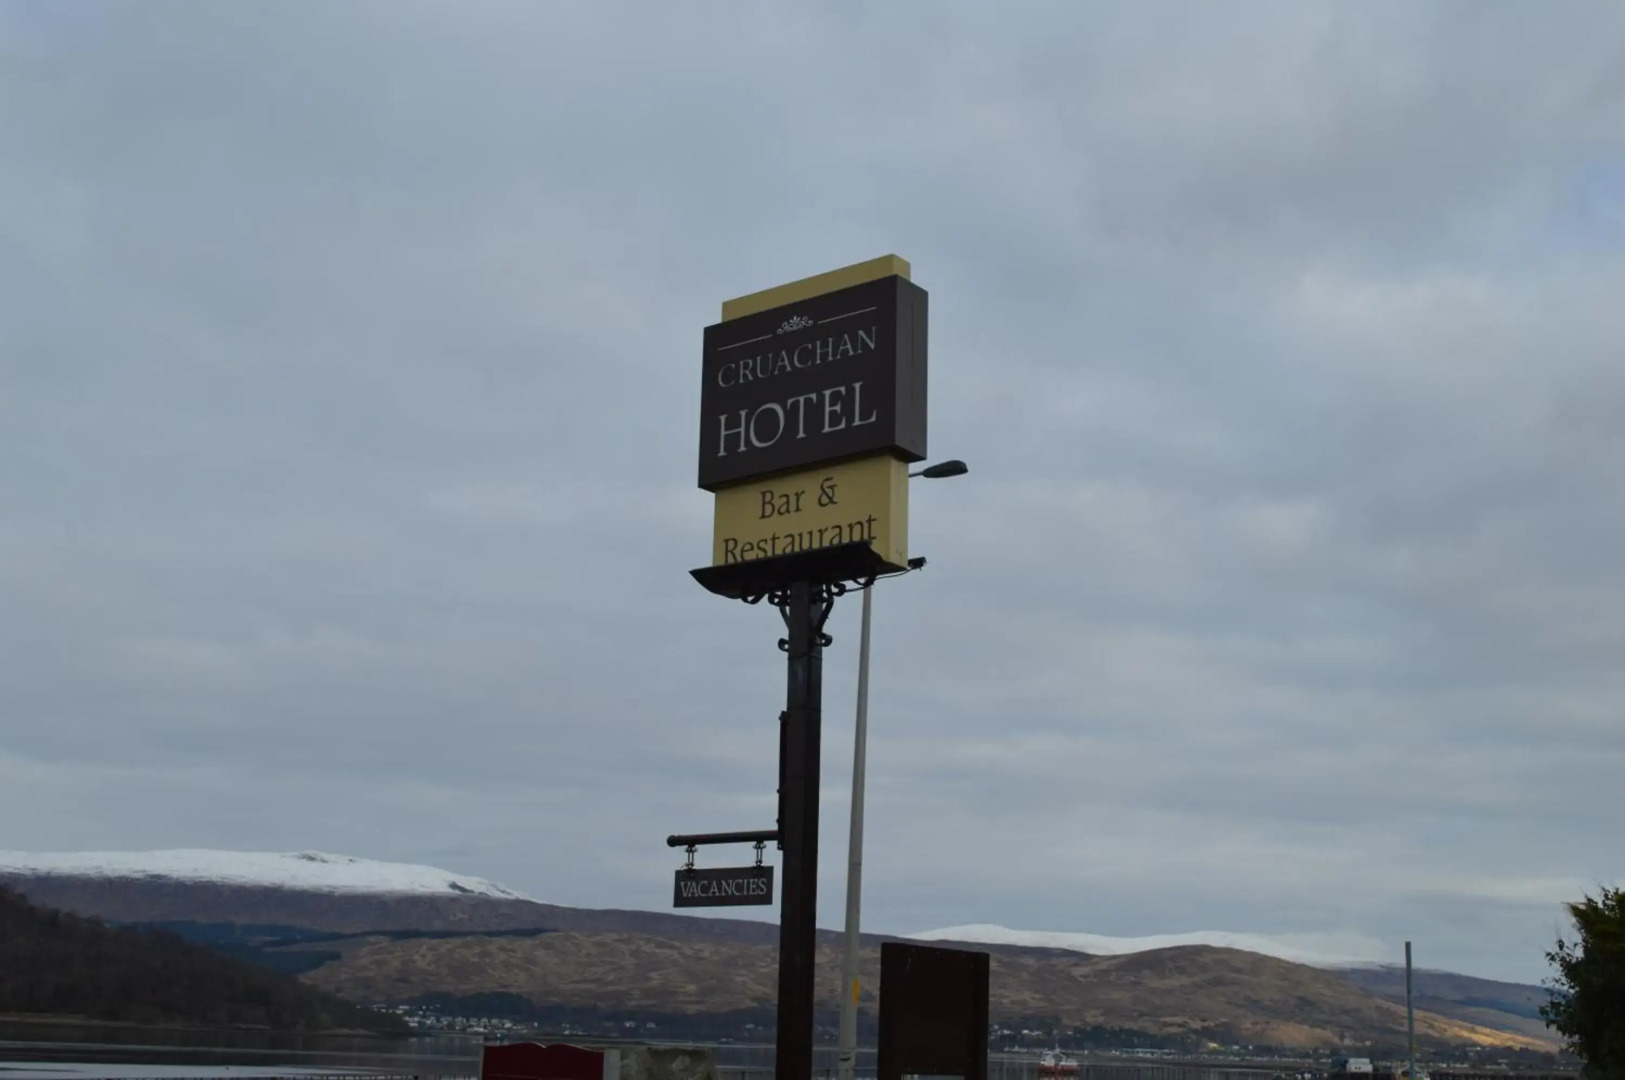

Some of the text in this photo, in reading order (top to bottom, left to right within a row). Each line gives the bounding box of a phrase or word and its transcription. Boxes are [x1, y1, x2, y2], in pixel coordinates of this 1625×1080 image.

[718, 326, 877, 387] CRUACHAN
[717, 381, 877, 457] HOTEL
[759, 477, 838, 520] Bar &
[723, 514, 877, 564] Restaurant
[680, 878, 767, 898] VACANCIES
